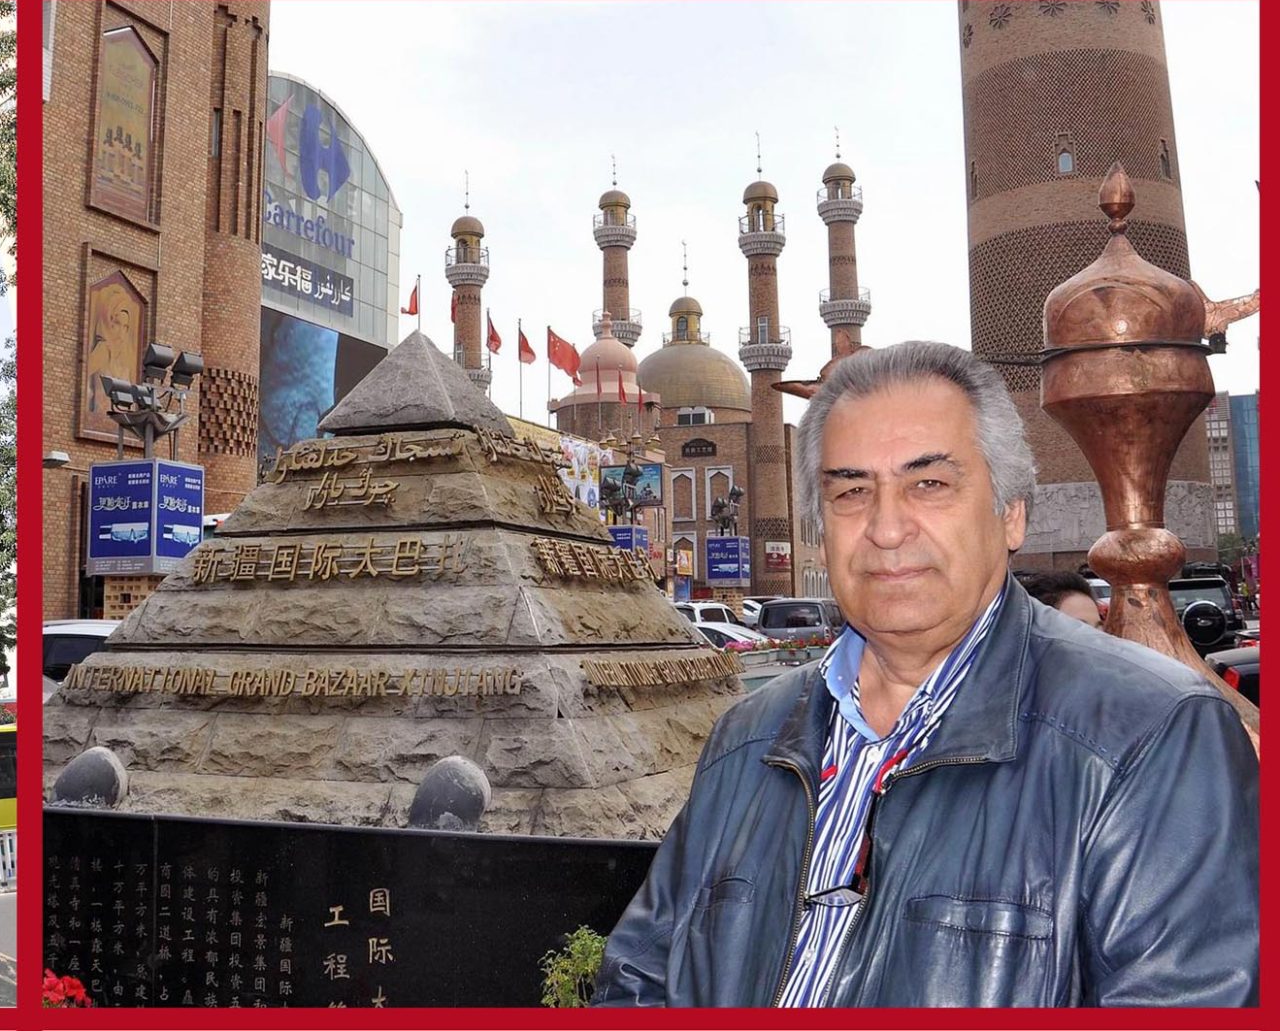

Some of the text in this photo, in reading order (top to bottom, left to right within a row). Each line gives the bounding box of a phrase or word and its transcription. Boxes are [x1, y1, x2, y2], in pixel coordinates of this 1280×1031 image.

[193, 535, 469, 584] 新疆国际大巴扎
[65, 663, 523, 697] INTERNATIONAL GRAND BAZAAR XINJIANG
[279, 914, 295, 1008] 新疆国际
[368, 887, 395, 1008] 国际大
